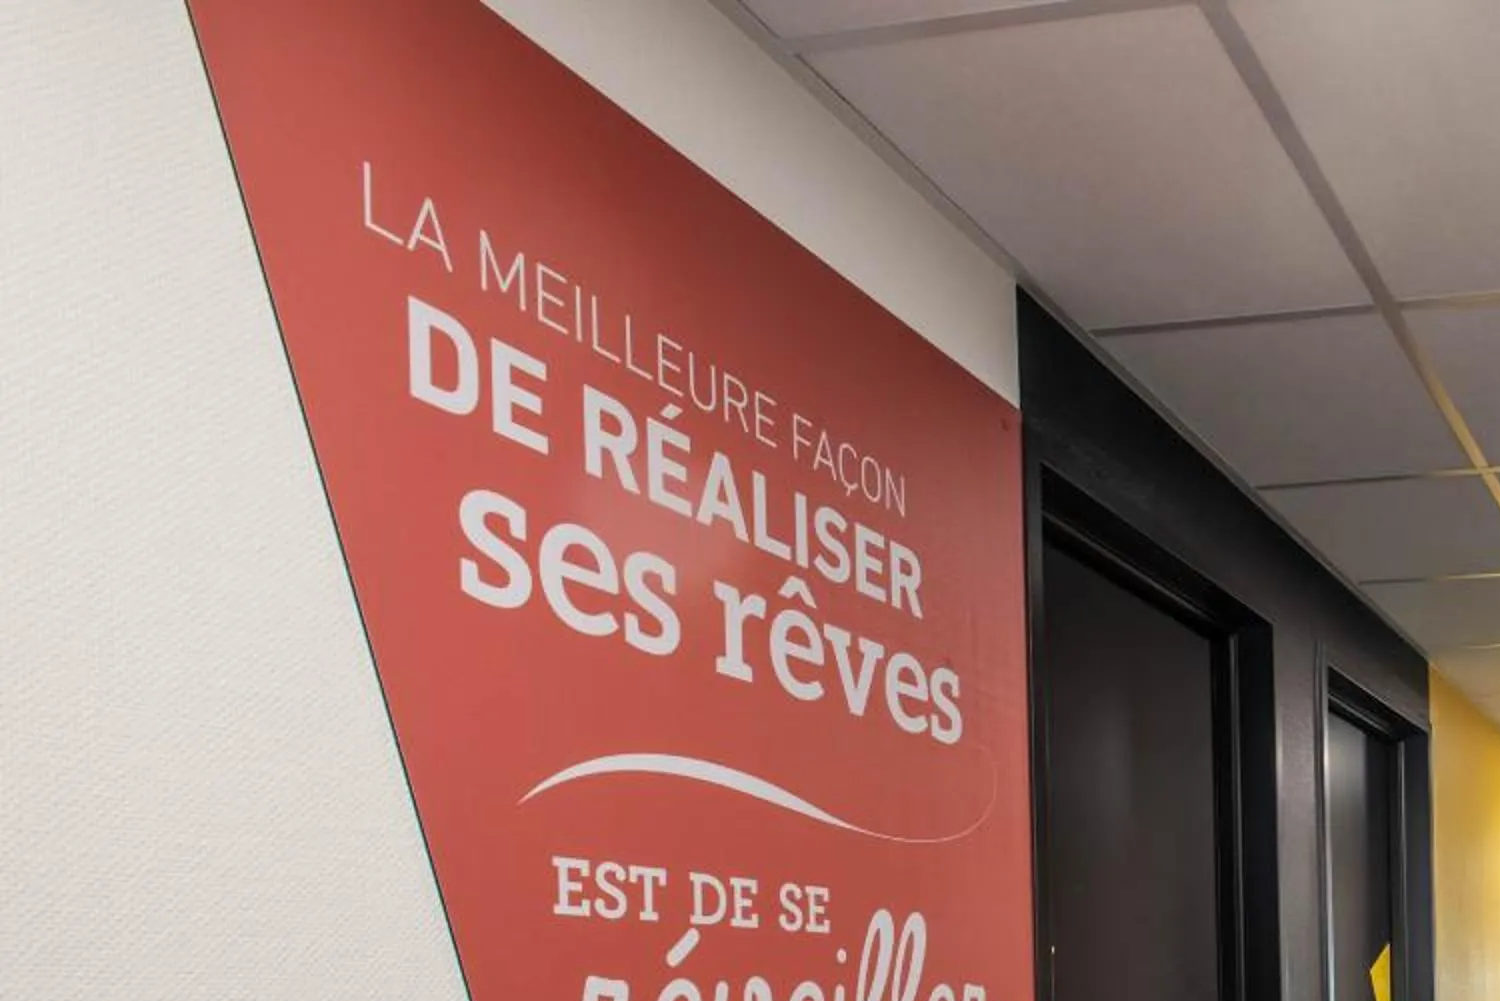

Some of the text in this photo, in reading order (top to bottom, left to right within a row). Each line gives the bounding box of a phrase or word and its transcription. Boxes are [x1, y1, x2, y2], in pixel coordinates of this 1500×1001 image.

[362, 160, 907, 517] LA MEILLEURE FAÇON
[408, 295, 924, 619] DE RÉALISER
[713, 574, 963, 745] rêves
[551, 855, 831, 934] EST DE SE
